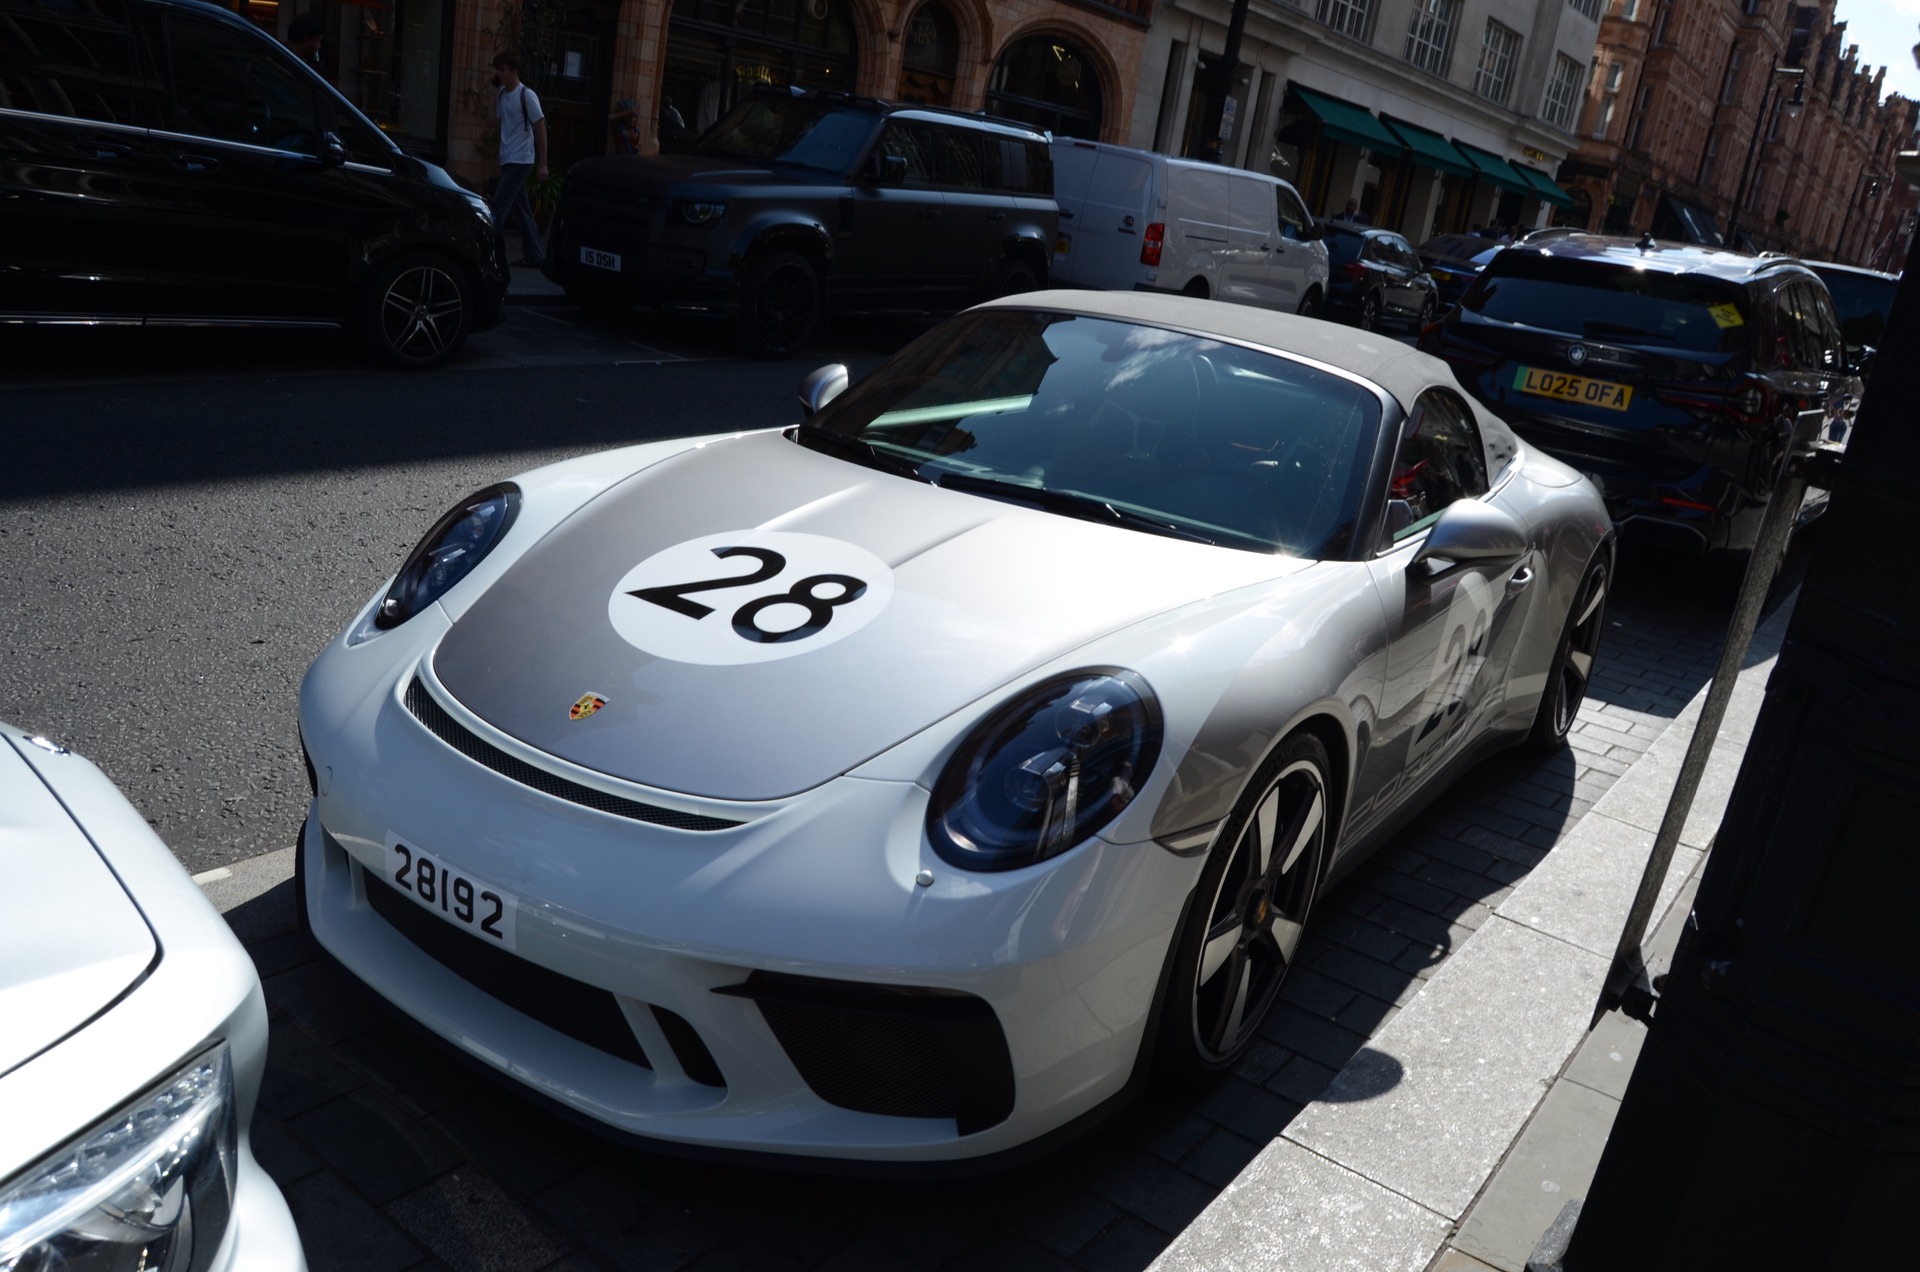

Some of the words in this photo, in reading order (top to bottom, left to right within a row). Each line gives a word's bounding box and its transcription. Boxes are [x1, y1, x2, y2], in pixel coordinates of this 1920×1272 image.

[586, 249, 594, 263] 15
[597, 253, 614, 268] DSH
[1585, 383, 1626, 408] OFA
[624, 544, 869, 644] 28
[394, 842, 504, 940] 28192
